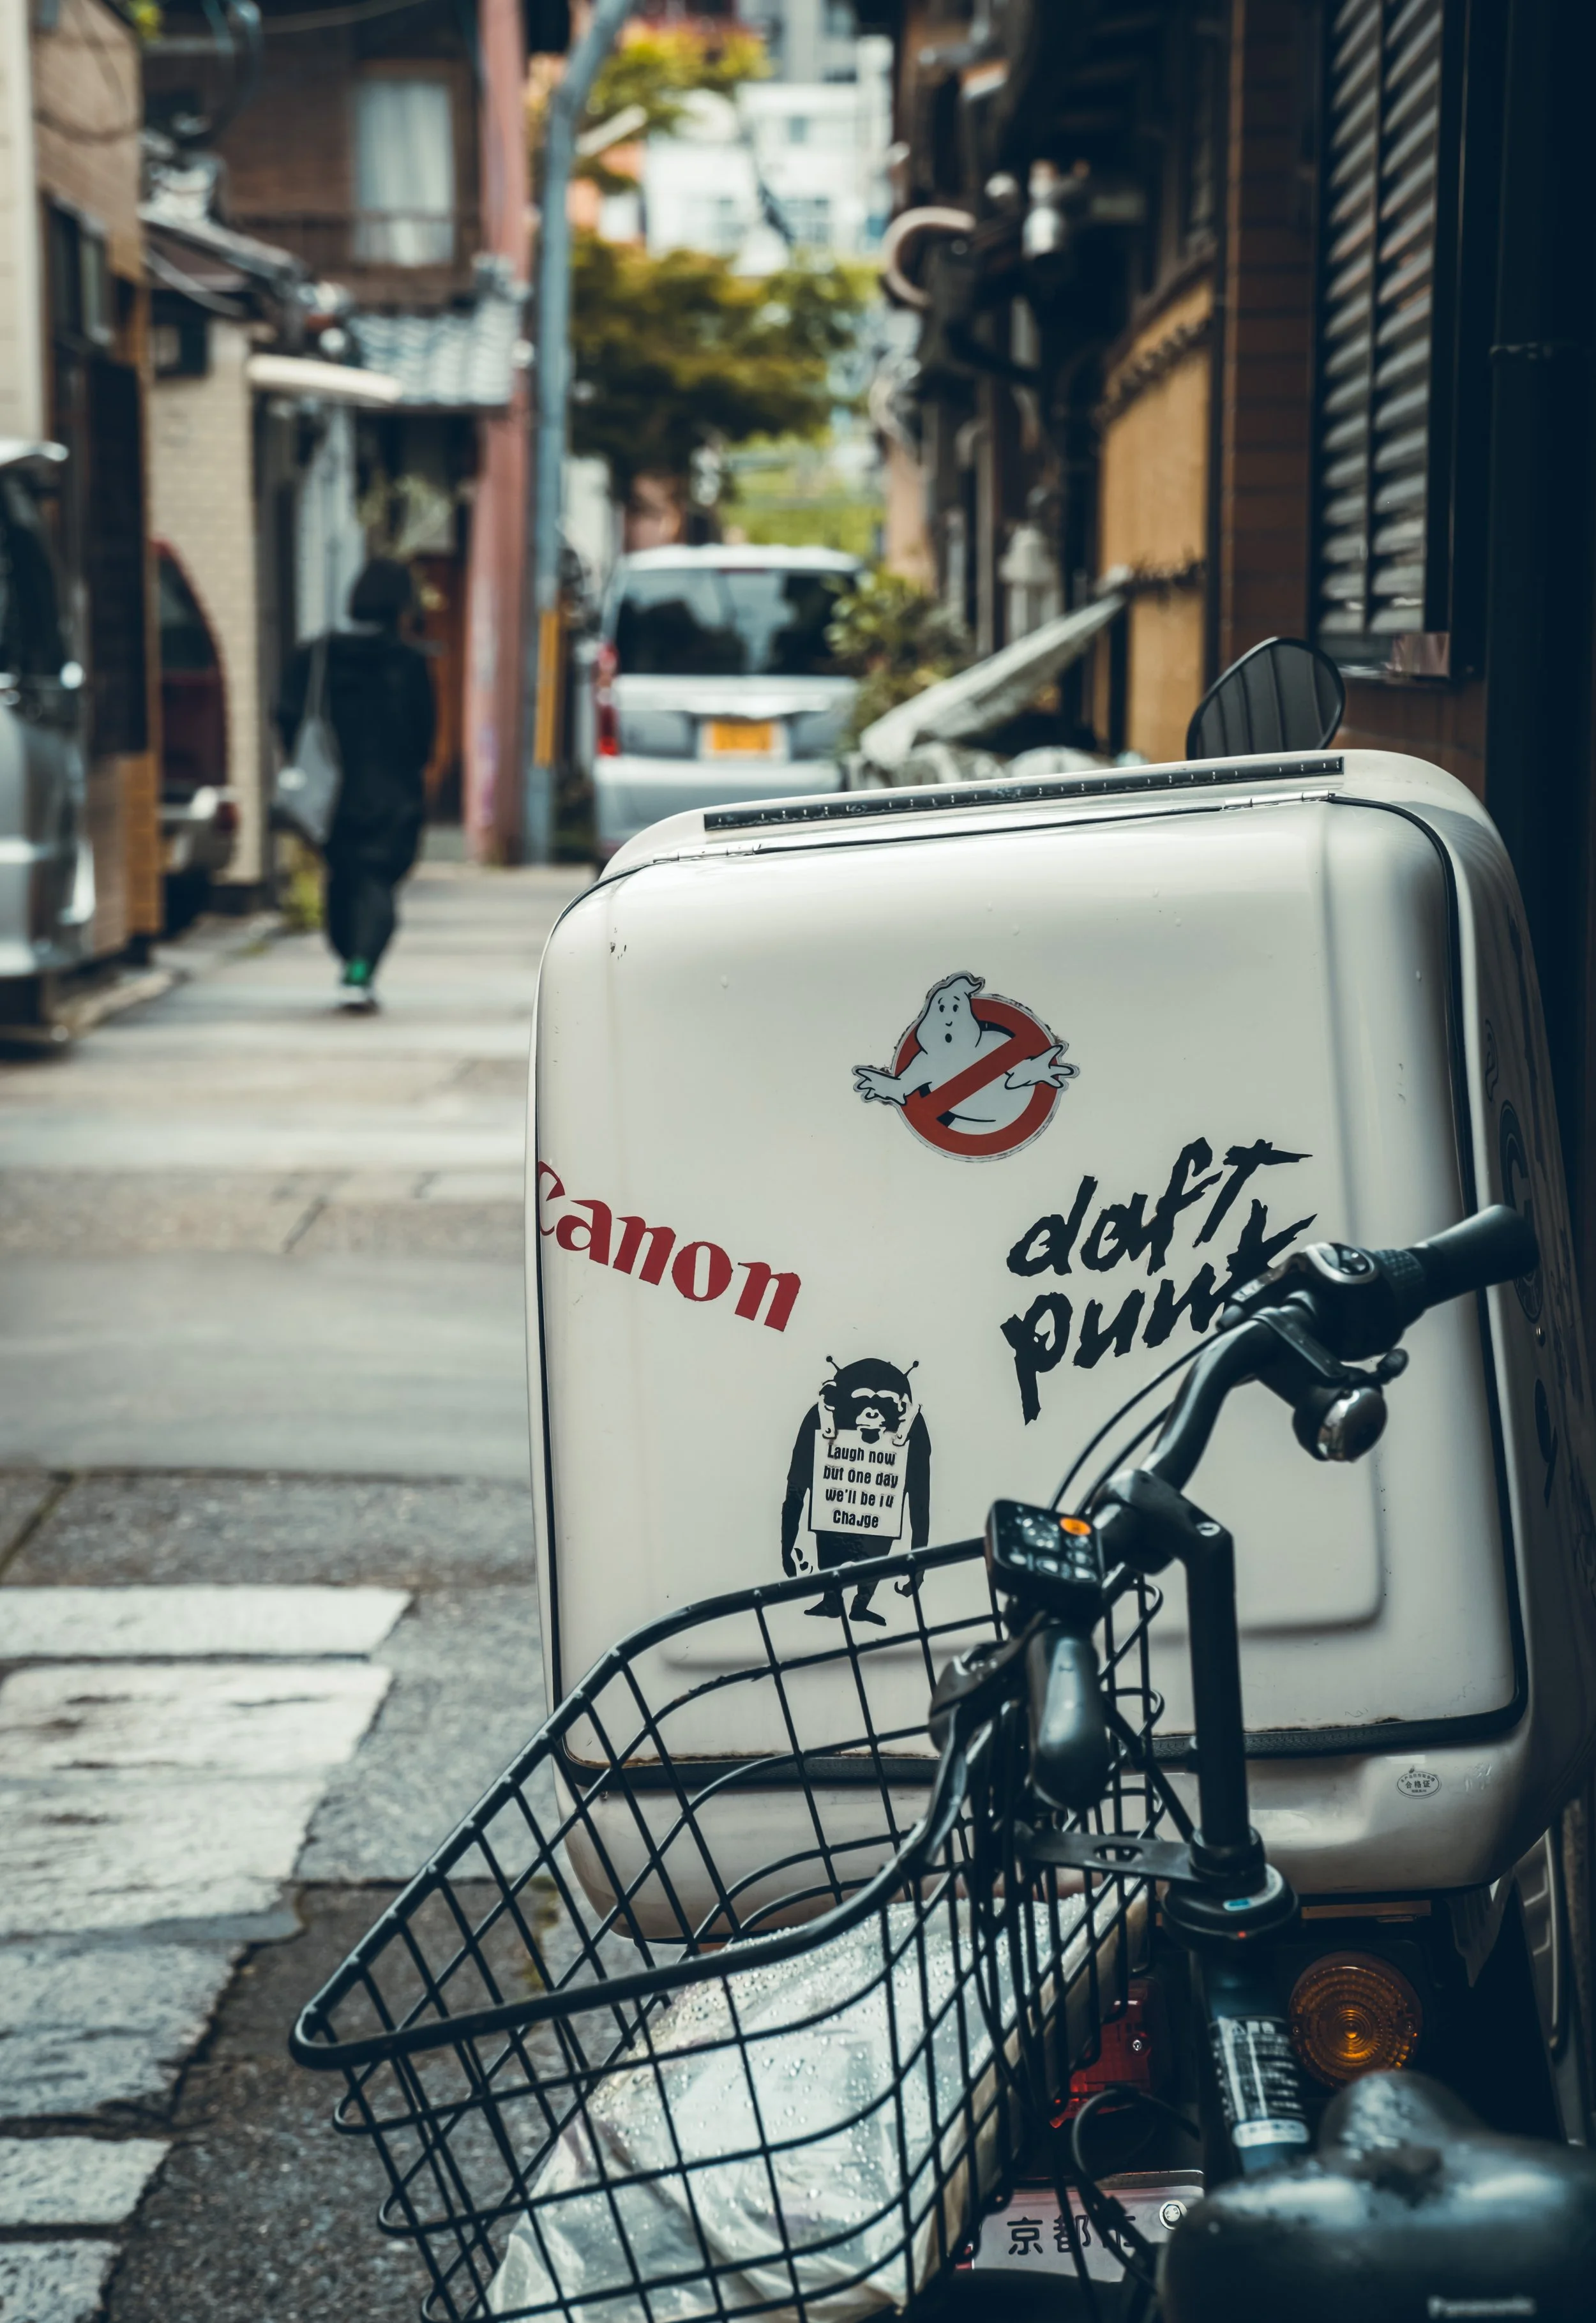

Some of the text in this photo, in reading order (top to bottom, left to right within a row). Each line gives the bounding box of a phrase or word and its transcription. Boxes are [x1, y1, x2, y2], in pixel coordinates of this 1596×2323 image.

[827, 1444, 896, 1466] Laugh now
[823, 1465, 844, 1481] but
[875, 1472, 898, 1489] day
[825, 1488, 856, 1504] we'll
[860, 1491, 875, 1507] be
[1007, 2216, 1136, 2256] 京都
